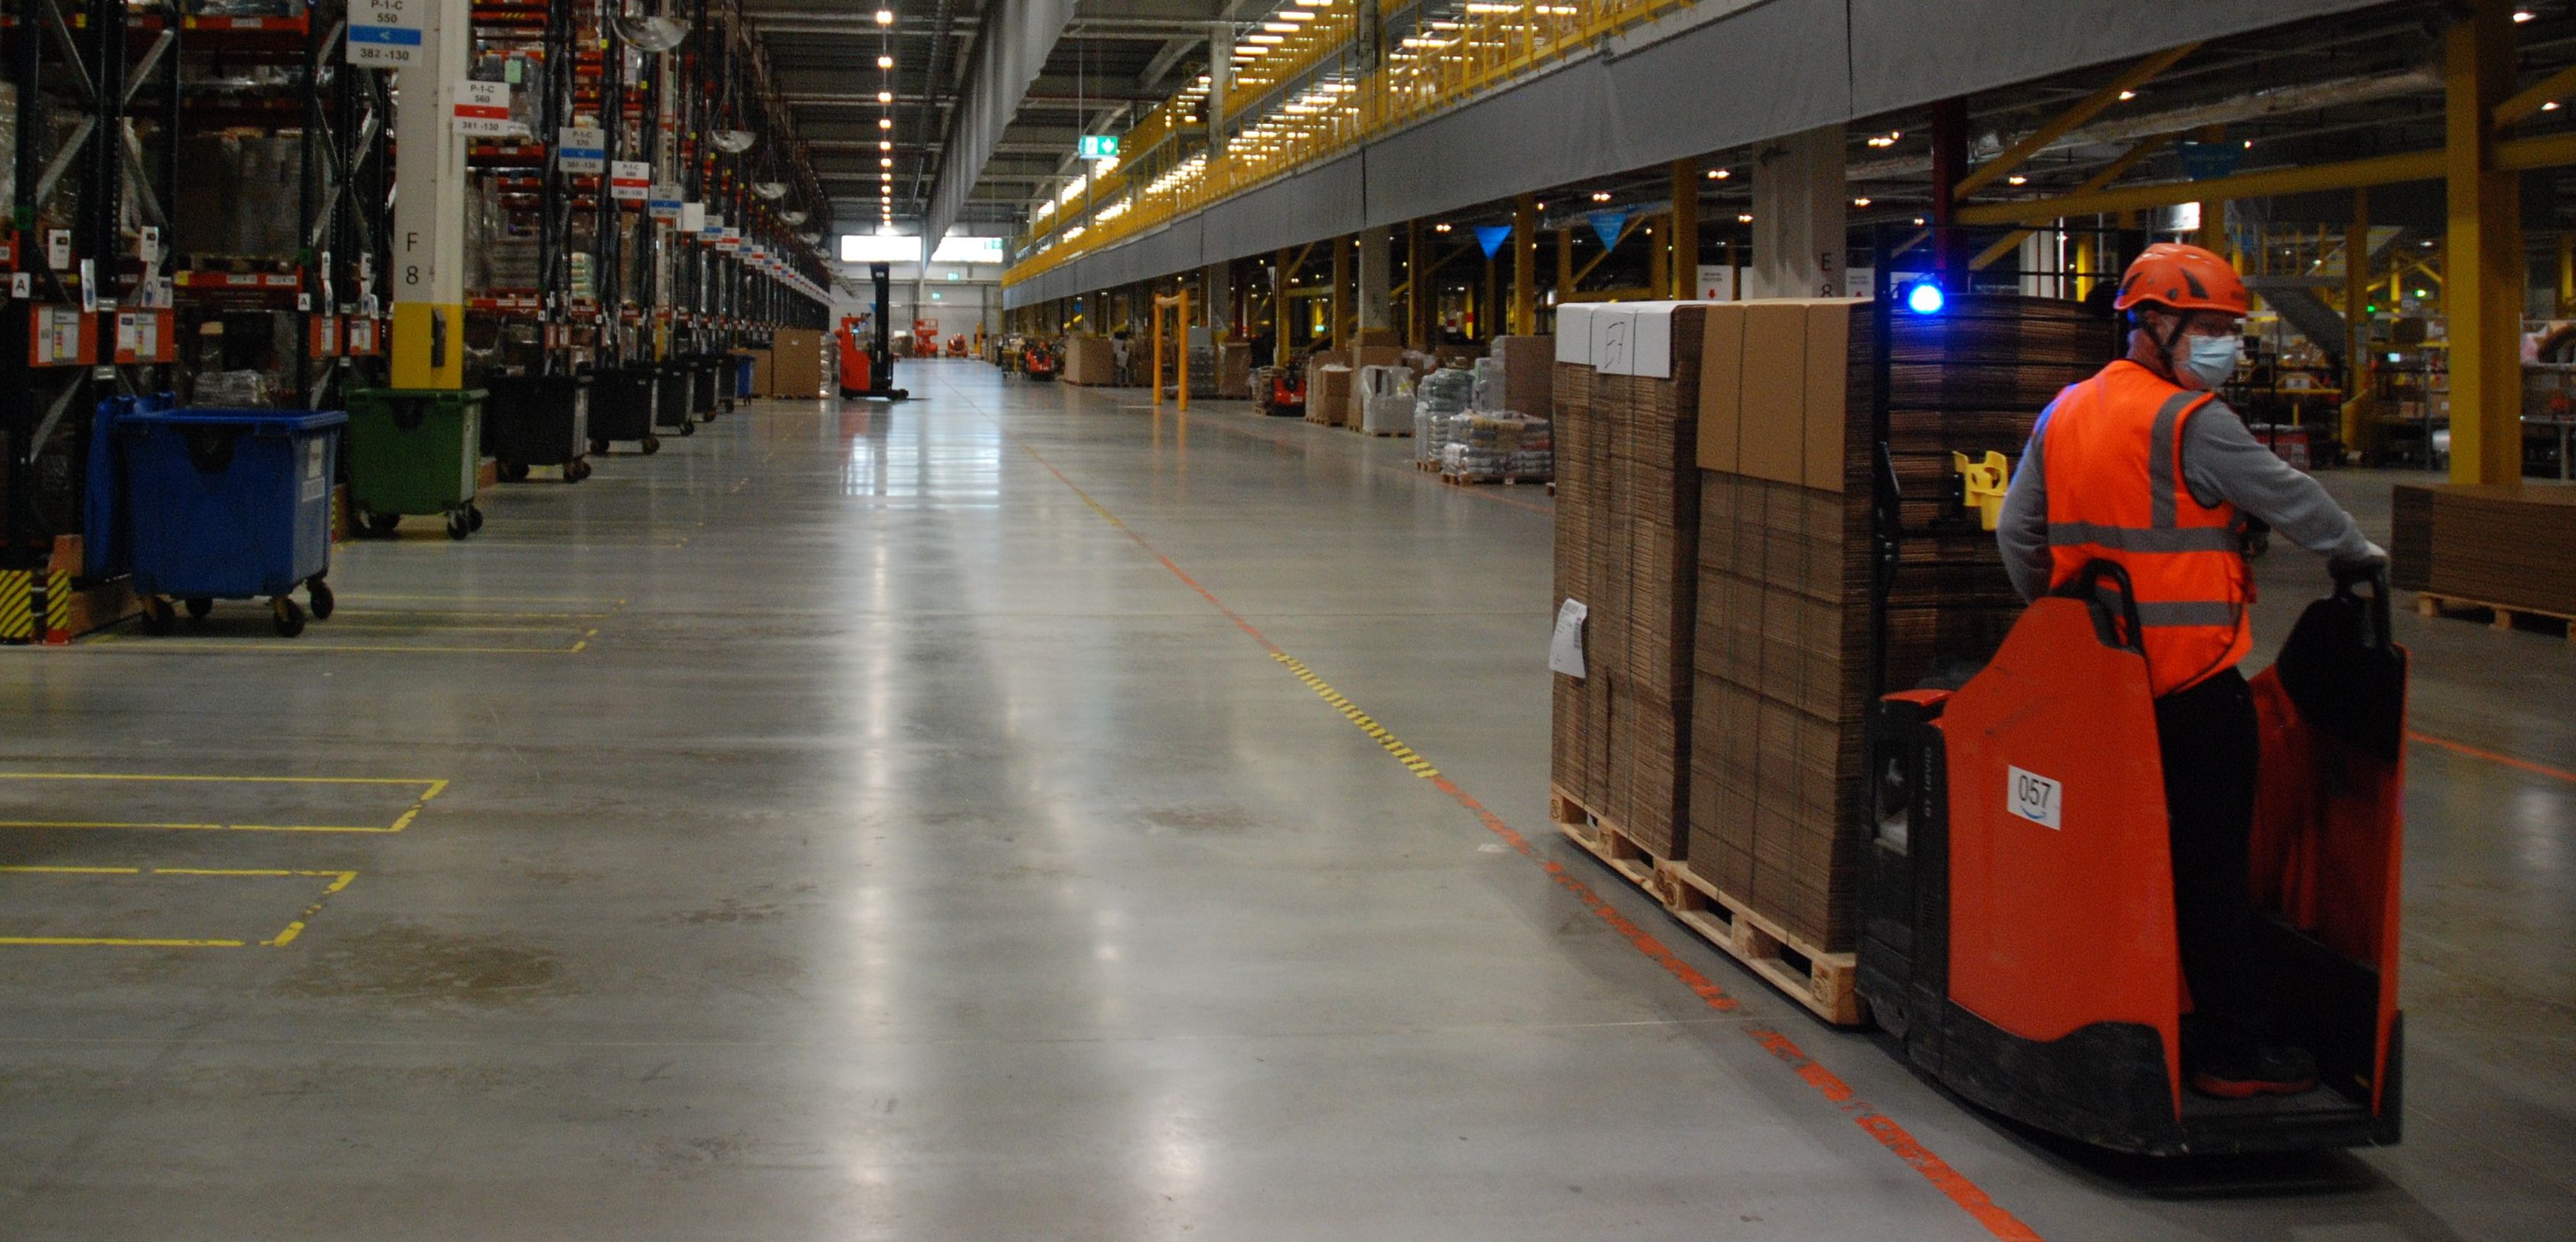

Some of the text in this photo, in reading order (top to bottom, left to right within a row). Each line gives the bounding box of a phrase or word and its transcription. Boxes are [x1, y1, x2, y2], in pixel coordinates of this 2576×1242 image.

[371, 0, 403, 10] P-1-C
[377, 13, 398, 23] 550
[360, 47, 410, 60] 382 -130
[470, 84, 495, 93] P-1-C
[406, 232, 420, 252] F
[1821, 253, 1833, 271] E
[406, 266, 419, 285] 8
[15, 279, 26, 292] A
[2018, 774, 2052, 809] 057
